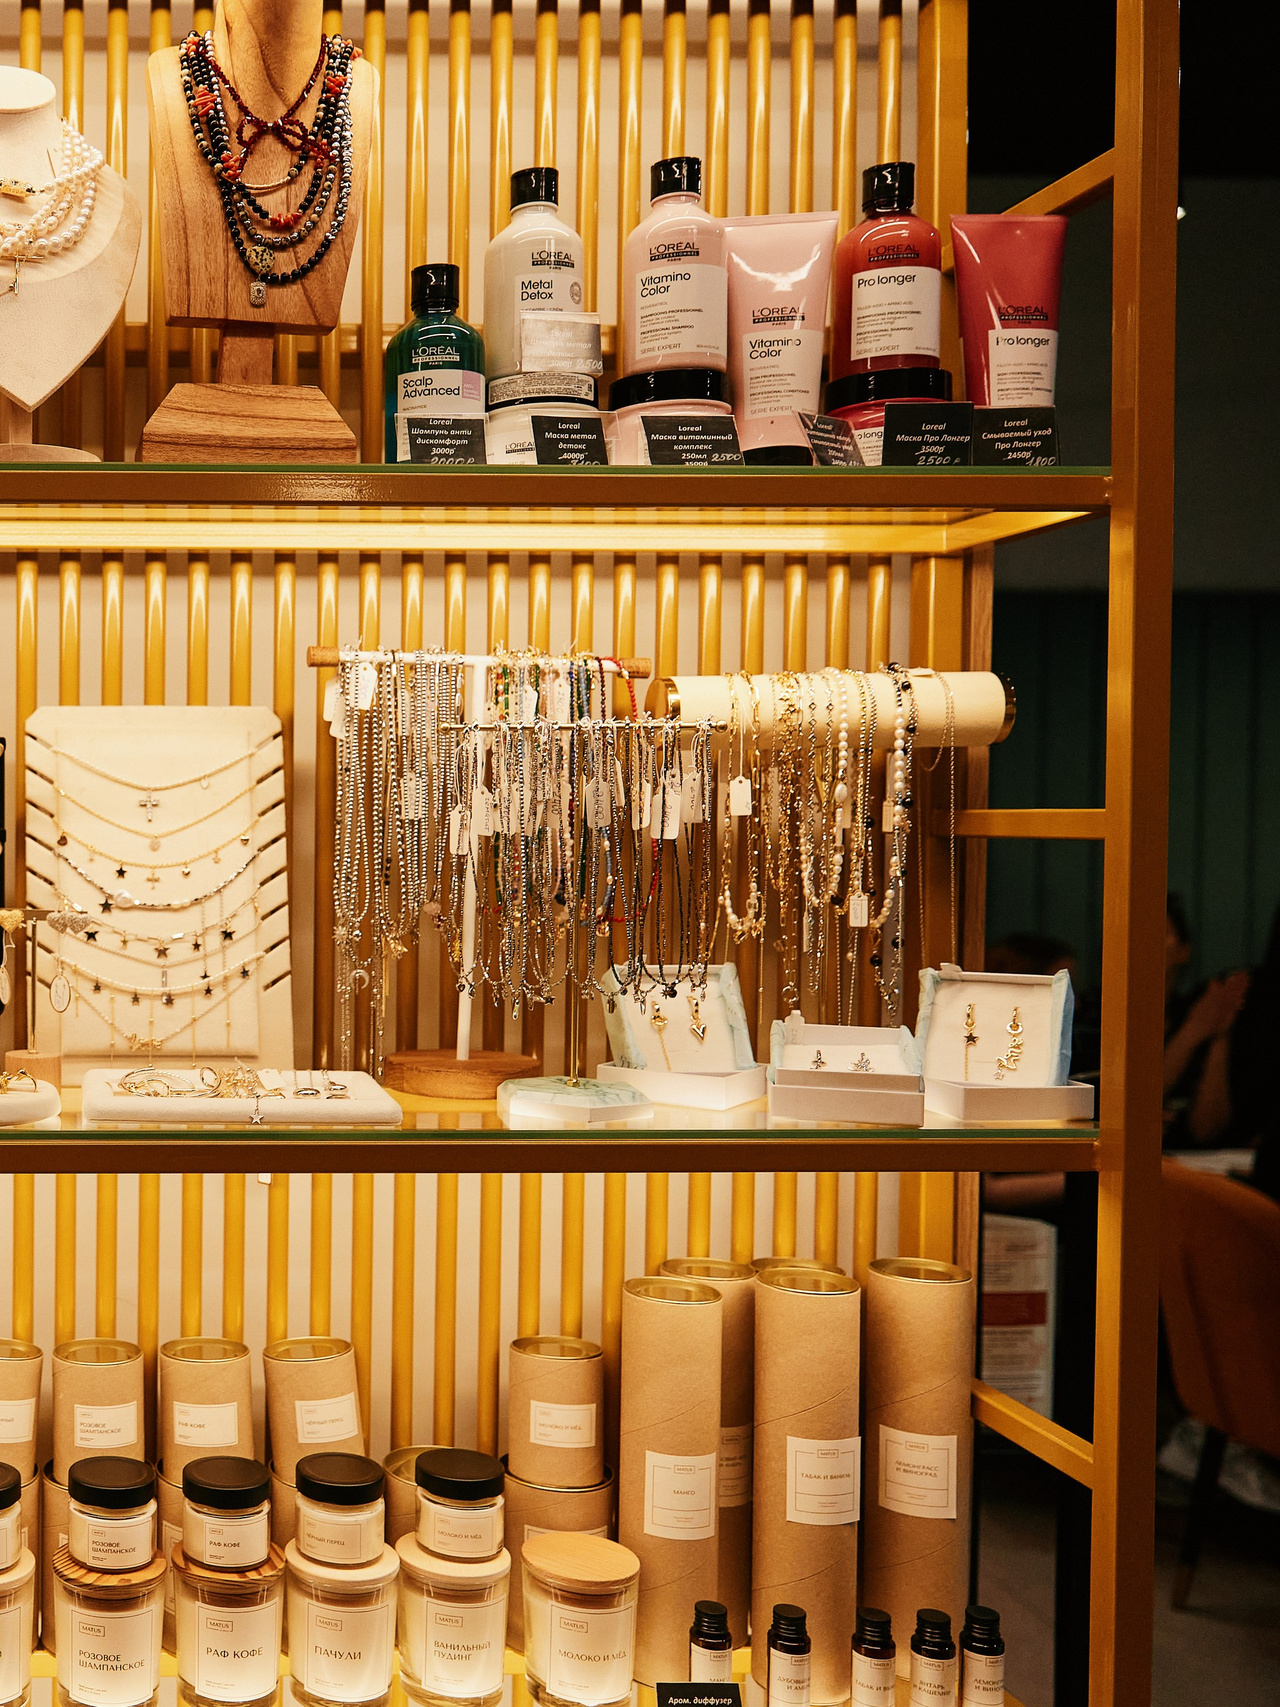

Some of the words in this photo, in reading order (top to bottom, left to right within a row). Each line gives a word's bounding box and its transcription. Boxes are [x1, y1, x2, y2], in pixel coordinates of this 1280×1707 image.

[521, 280, 553, 290] Metal
[640, 272, 691, 288] Vitamino
[857, 278, 876, 289] Pro
[877, 274, 916, 286] longer
[521, 289, 553, 301] Detox
[640, 284, 671, 298] Color
[749, 337, 802, 350] Vitamino
[1016, 335, 1050, 347] longer
[411, 345, 460, 357] L'ORÉAL
[749, 348, 782, 360] Color
[402, 376, 433, 389] Scalp
[402, 386, 460, 400] Advanced
[921, 422, 947, 431] Loreal
[1004, 418, 1029, 427] Loreal
[411, 427, 449, 436] Шампунь
[544, 431, 569, 439] Маска
[570, 432, 597, 440] метал
[981, 429, 1033, 440] Смываемый
[1033, 428, 1052, 438] уход
[416, 437, 469, 446] дискомфорт
[895, 434, 922, 442] Маска
[923, 434, 940, 443] Про
[940, 434, 971, 443] Лонгер
[558, 441, 587, 449] детокс
[995, 441, 1012, 450] Про
[1013, 440, 1042, 449] Лонгер
[681, 452, 708, 460] 250мл
[710, 452, 742, 462] 2500
[916, 455, 951, 466] 2500
[801, 1472, 822, 1480] ТАБАК
[438, 1530, 463, 1539] МОЛОКО
[92, 1540, 120, 1548] РОЗОВОЕ
[209, 1621, 230, 1629] MATUS
[438, 1616, 460, 1625] MATUS
[434, 1640, 491, 1651] ВАНИЛЬНЫЙ
[78, 1649, 122, 1662] РОЗОВОЕ
[206, 1647, 230, 1658] РАФ
[233, 1647, 263, 1659] КОФЕ
[314, 1645, 362, 1660] ПАЧУЛИ
[433, 1650, 472, 1661] ПУДИНГ
[559, 1649, 601, 1662] МОЛОКО
[611, 1650, 626, 1660] МЁД
[78, 1659, 145, 1672] ШАМПАНСКОЕ
[668, 1696, 691, 1705] Аром.
[693, 1696, 732, 1706] диффузер
